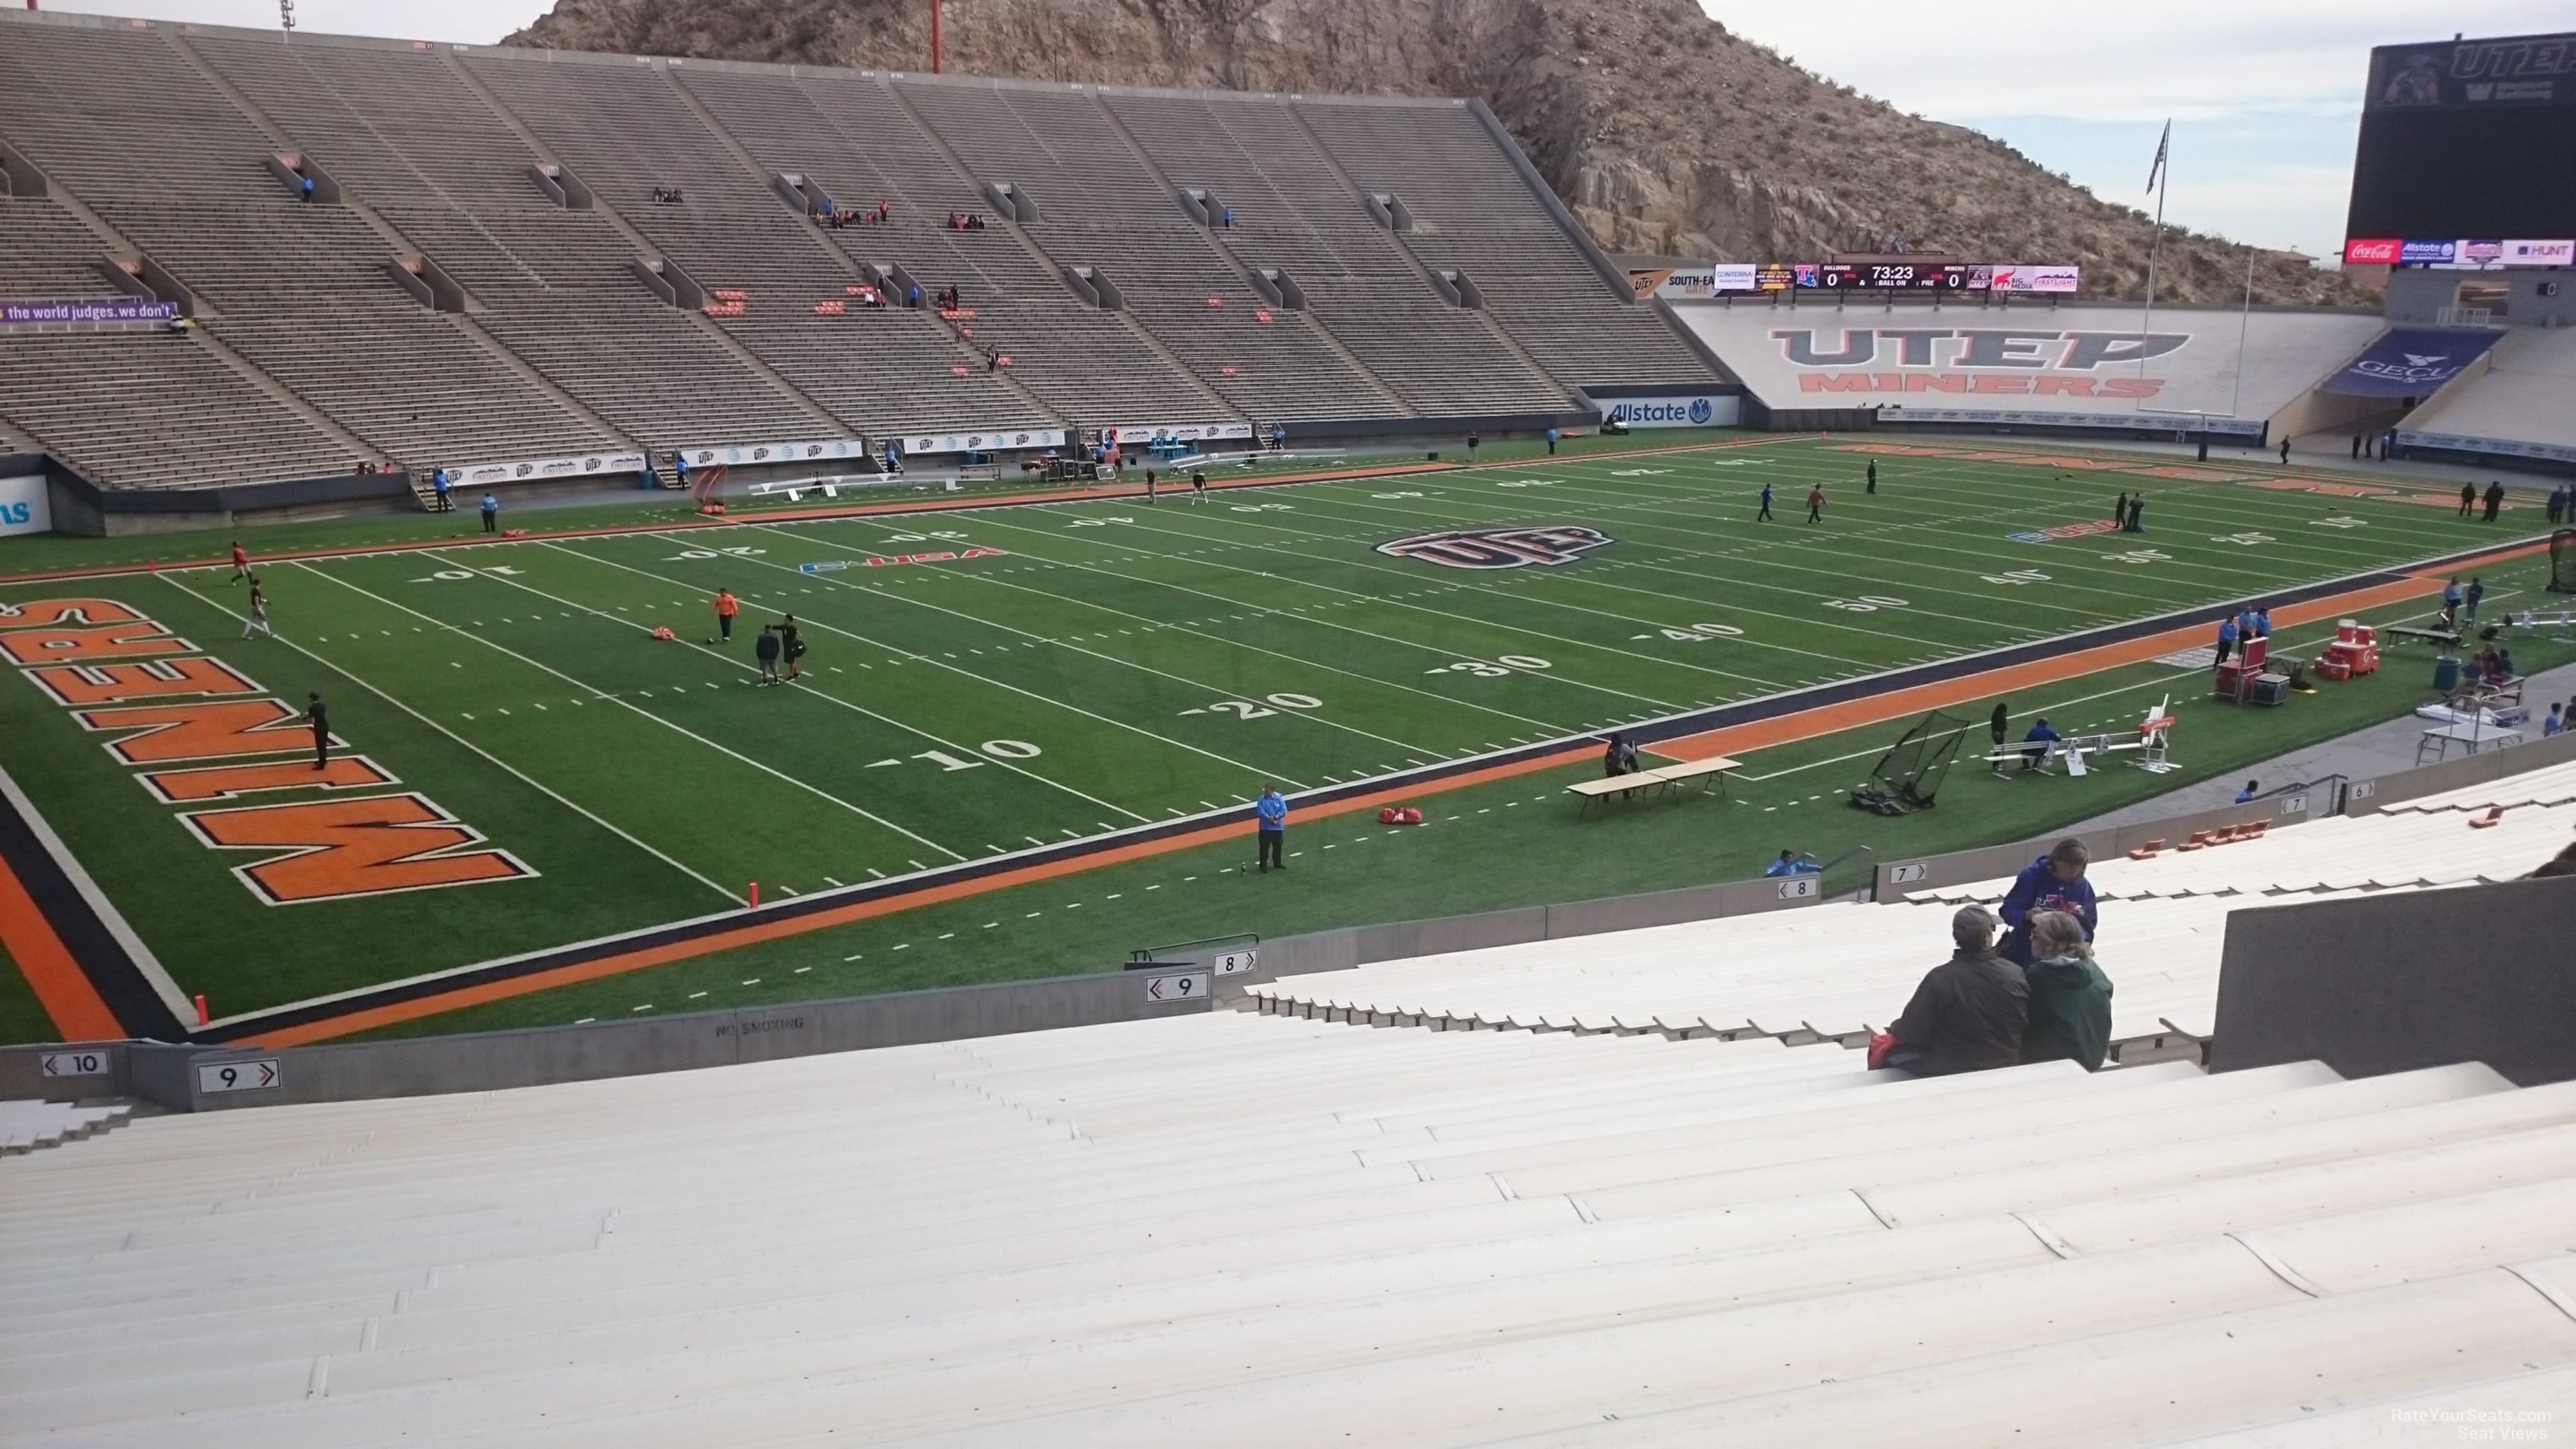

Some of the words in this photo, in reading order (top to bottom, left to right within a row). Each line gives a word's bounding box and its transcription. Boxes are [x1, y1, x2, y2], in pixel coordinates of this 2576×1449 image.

[2402, 243, 2440, 252] Allstate
[2531, 246, 2569, 256] HUNT
[1668, 275, 1715, 285] SOUTH-EA
[1827, 274, 1837, 286] 0
[1871, 266, 1913, 279] 73:23
[1949, 274, 1959, 287] 0
[1685, 286, 1707, 294] GATE
[8, 307, 30, 319] the
[33, 305, 68, 319] world
[140, 304, 170, 318] don't
[1768, 328, 2194, 370] UTEP
[2358, 360, 2462, 377] GECU
[1799, 373, 2166, 397] MINERS
[1609, 402, 1686, 422] Allstate
[2101, 549, 2173, 564] 30
[433, 565, 526, 580] 10
[1979, 569, 2053, 586] 40
[1821, 596, 1911, 612] 50
[1659, 623, 1745, 642] 40
[1448, 655, 1553, 677] 30
[1208, 692, 1323, 720] 20
[910, 739, 1042, 772] 10
[2356, 786, 2362, 797] 6
[2293, 799, 2301, 810] 7
[1898, 868, 1907, 881] 7
[1798, 882, 1806, 894] 8
[1225, 956, 1234, 971] 8
[1178, 978, 1192, 996] 9
[716, 1024, 735, 1038] NO
[742, 1017, 804, 1035] SMOKING
[72, 1055, 97, 1072] 10
[219, 1067, 238, 1088] 9
